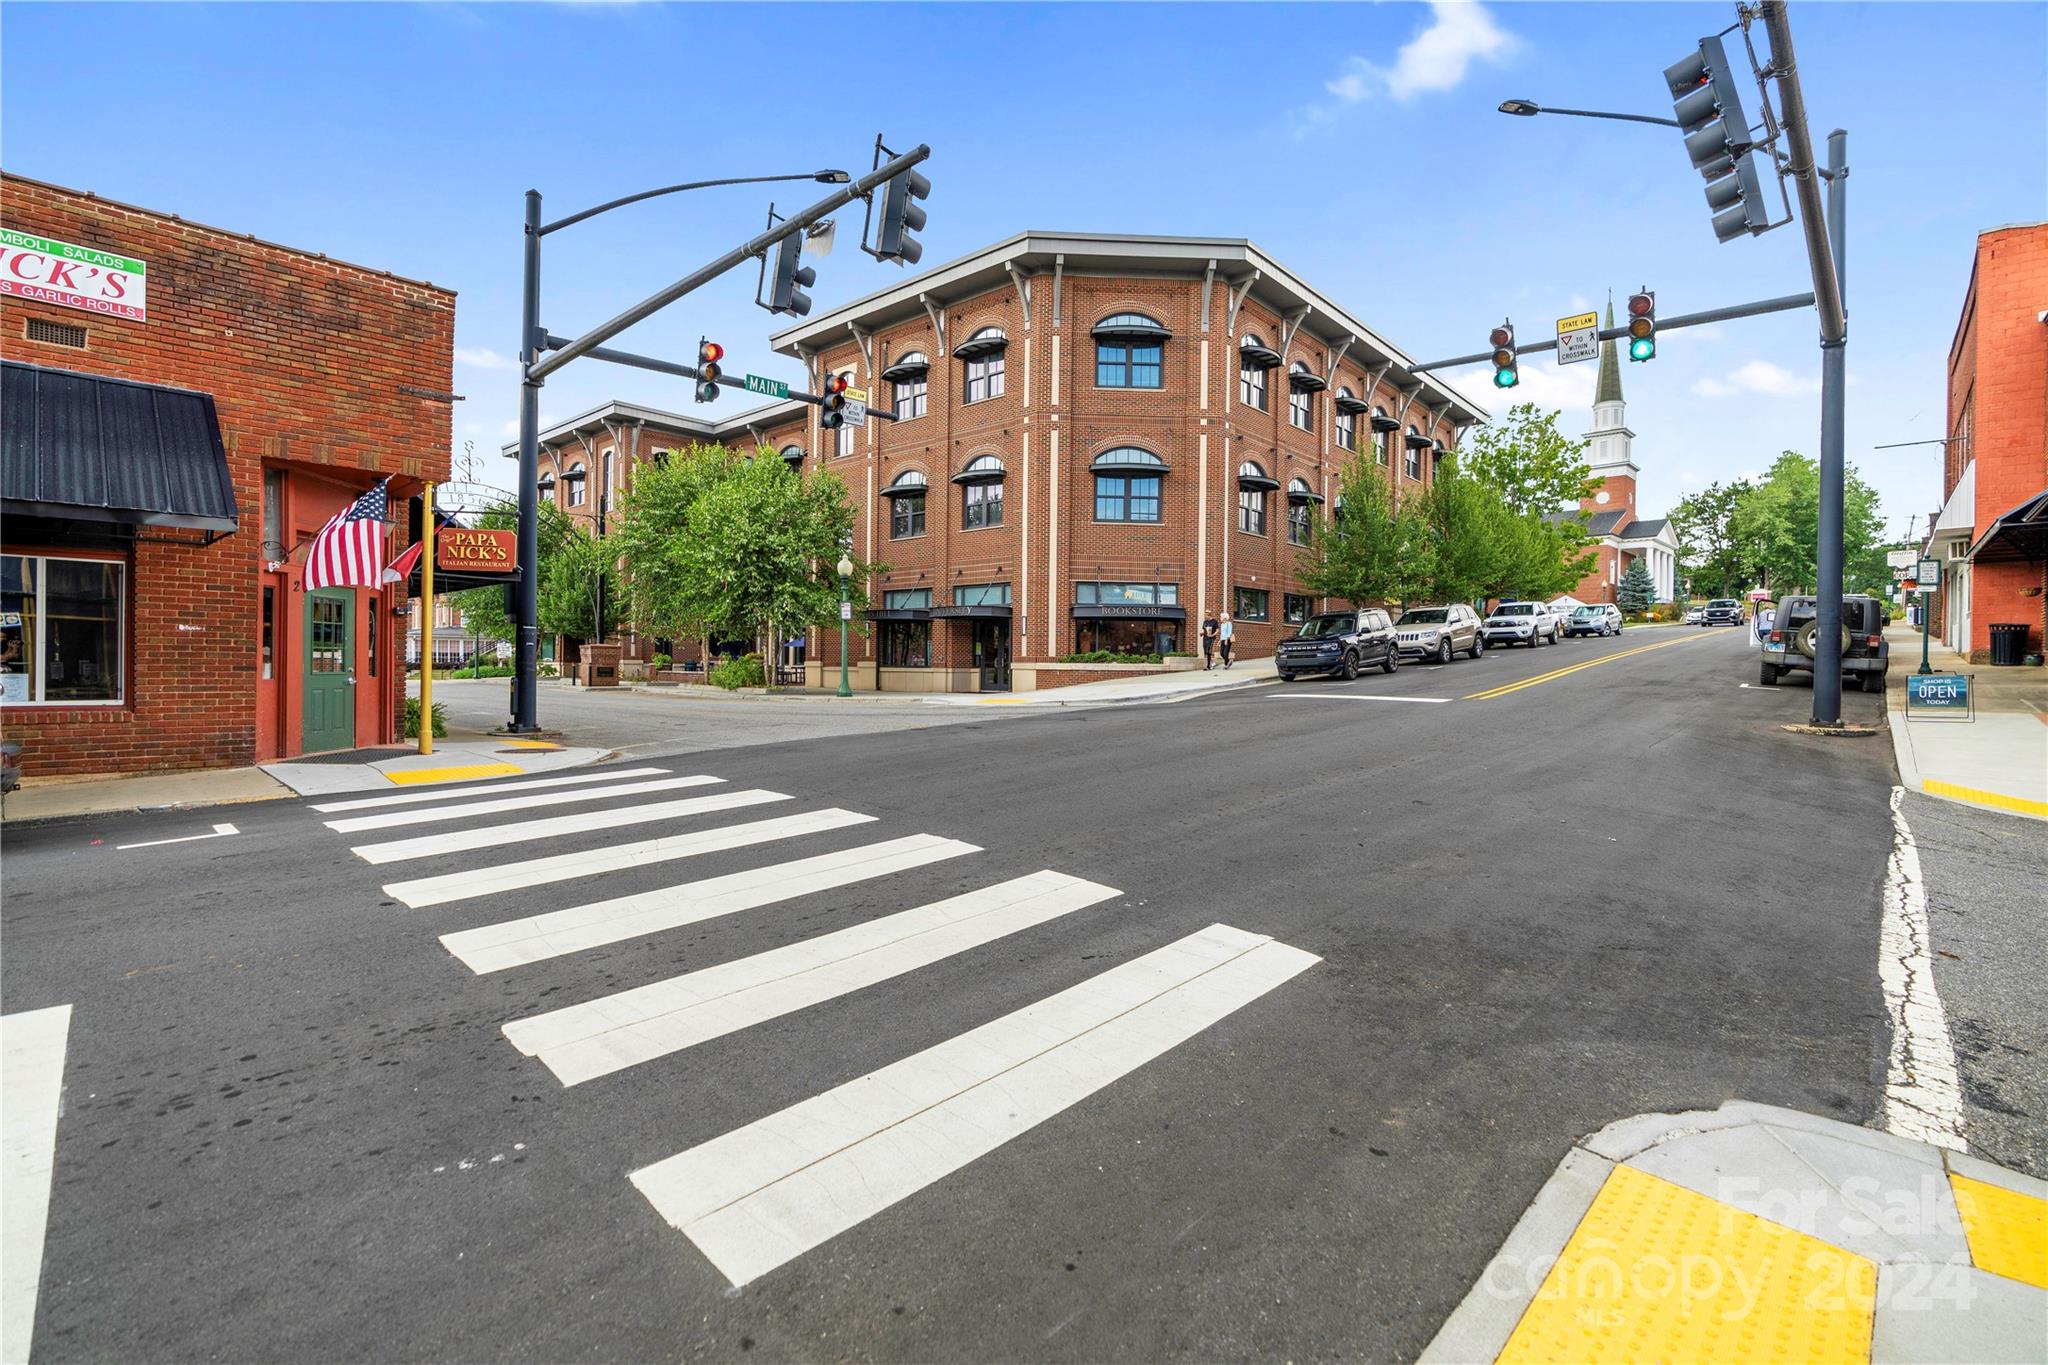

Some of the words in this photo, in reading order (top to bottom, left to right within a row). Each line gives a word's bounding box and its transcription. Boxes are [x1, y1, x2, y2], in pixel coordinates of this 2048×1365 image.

[63, 247, 125, 269] SALADS
[0, 248, 128, 299] CK'S
[22, 286, 82, 306] GARLIC
[86, 300, 136, 317] ROLLS
[1562, 320, 1578, 329] STATE
[1580, 317, 1592, 325] LAW
[1562, 349, 1595, 359] CROSSWALK
[749, 377, 778, 396] MAIN
[456, 533, 498, 546] PAPA
[447, 546, 507, 560] NICK'S
[1101, 607, 1163, 616] BOOKSTORE
[1919, 686, 1957, 698] OPEN
